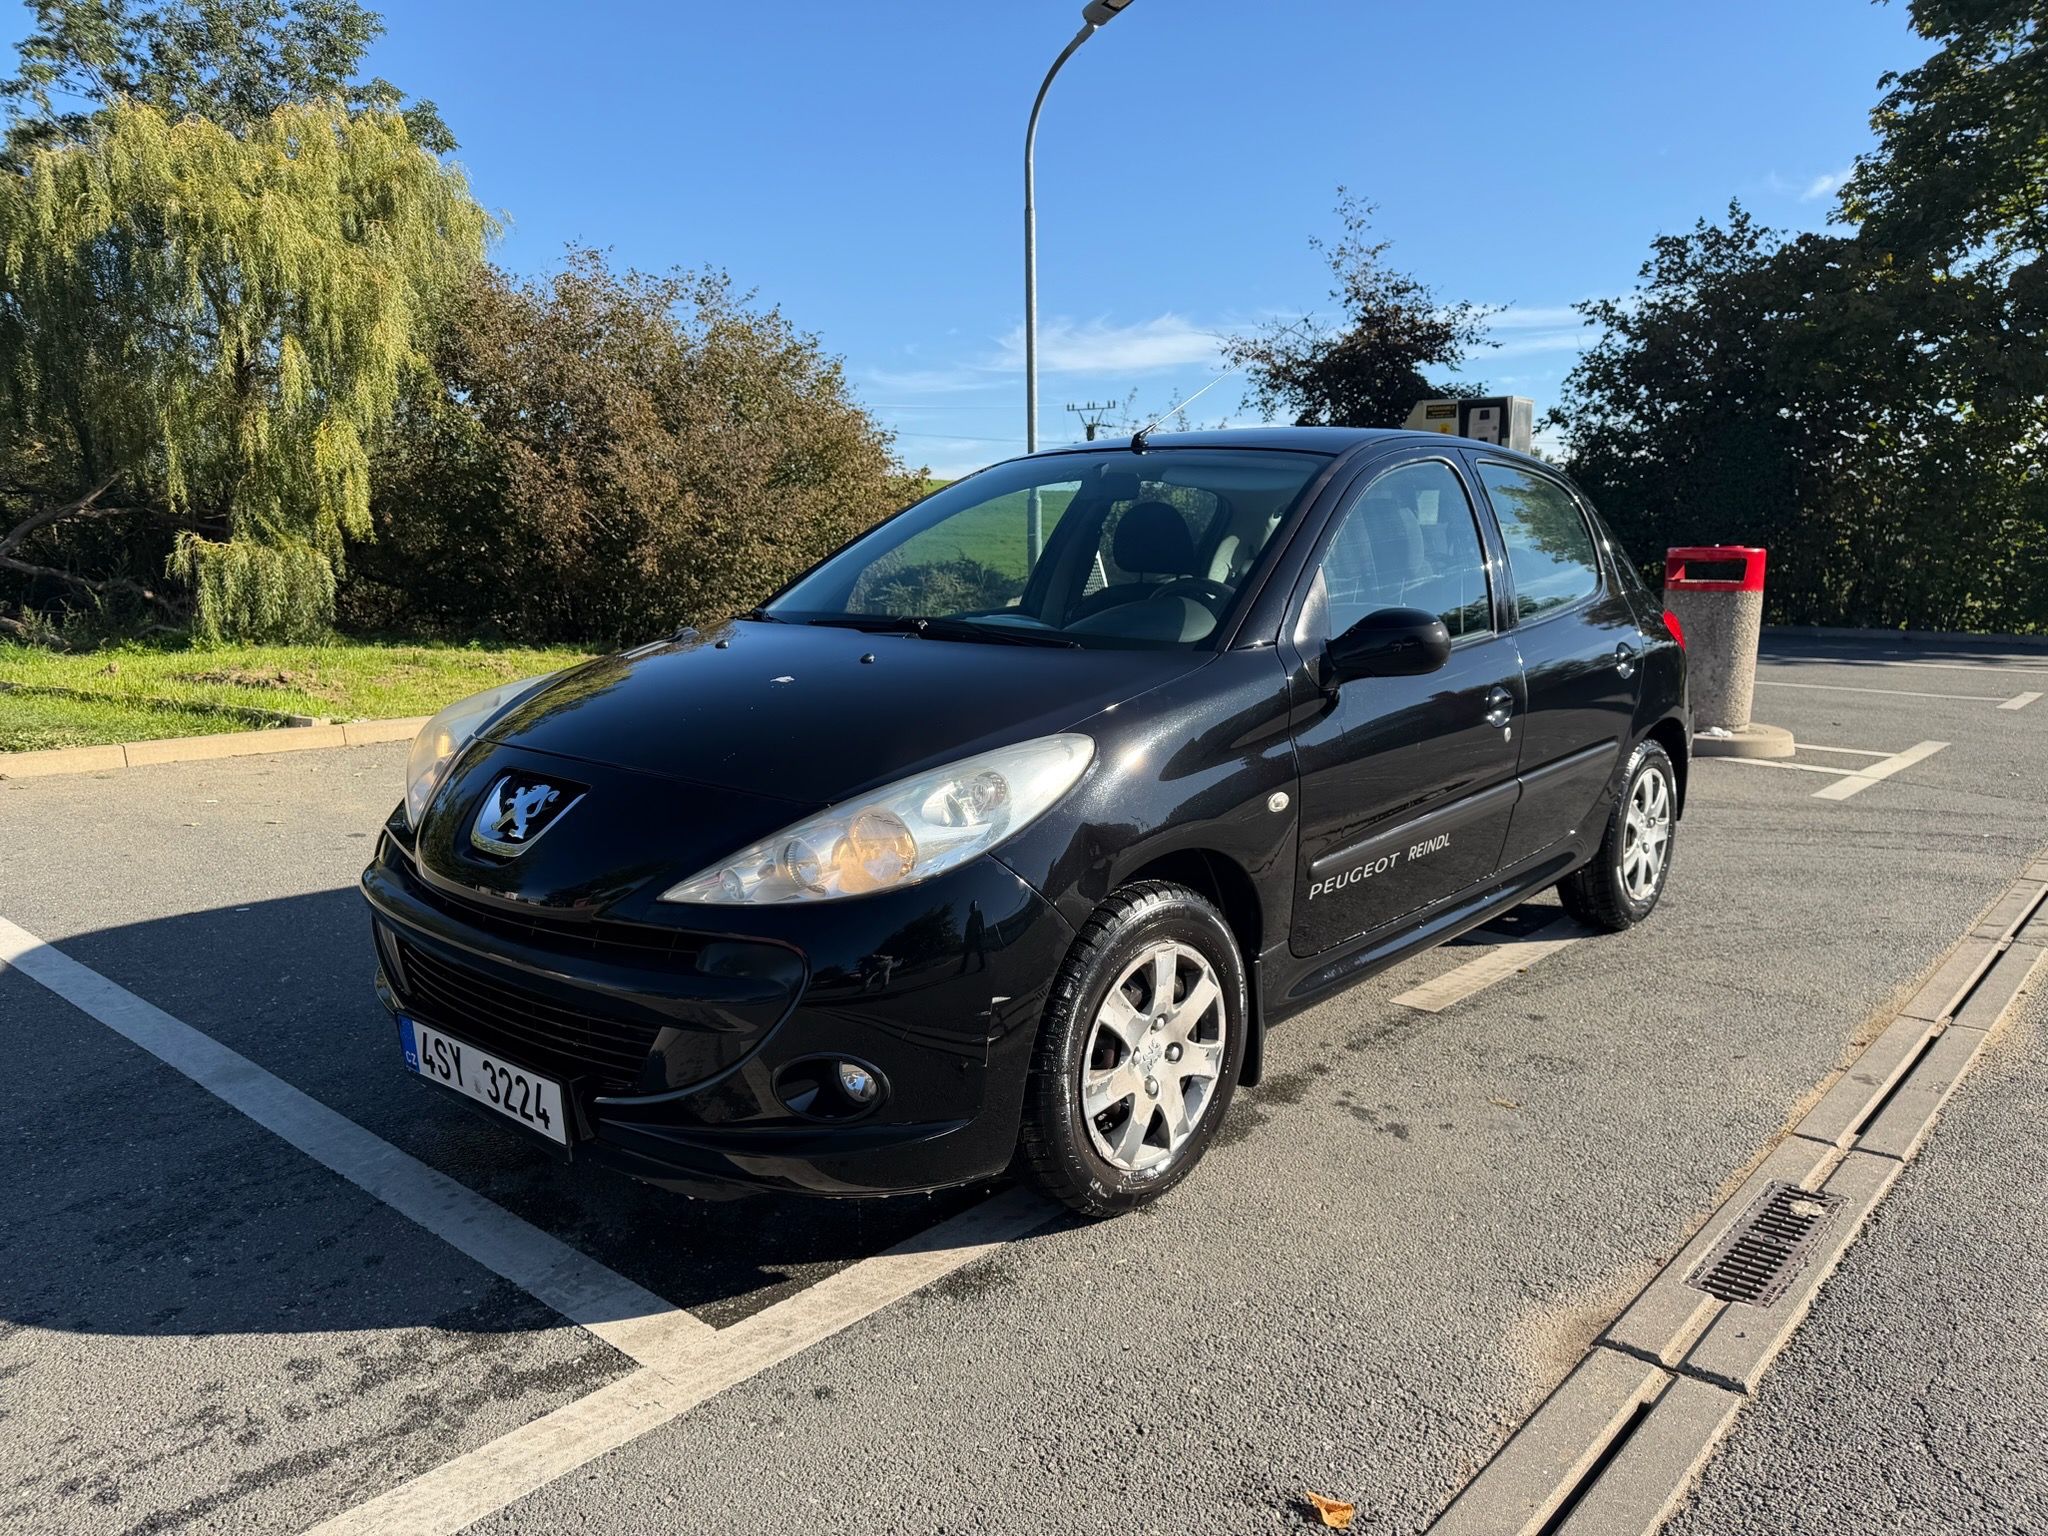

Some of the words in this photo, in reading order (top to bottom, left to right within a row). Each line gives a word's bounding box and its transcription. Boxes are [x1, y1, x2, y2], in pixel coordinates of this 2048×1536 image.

[1309, 852, 1400, 900] PEUGEOT
[1408, 833, 1450, 862] REINDL
[405, 1050, 417, 1066] CZ
[422, 1032, 463, 1087] 4SY
[482, 1060, 550, 1130] 3224
